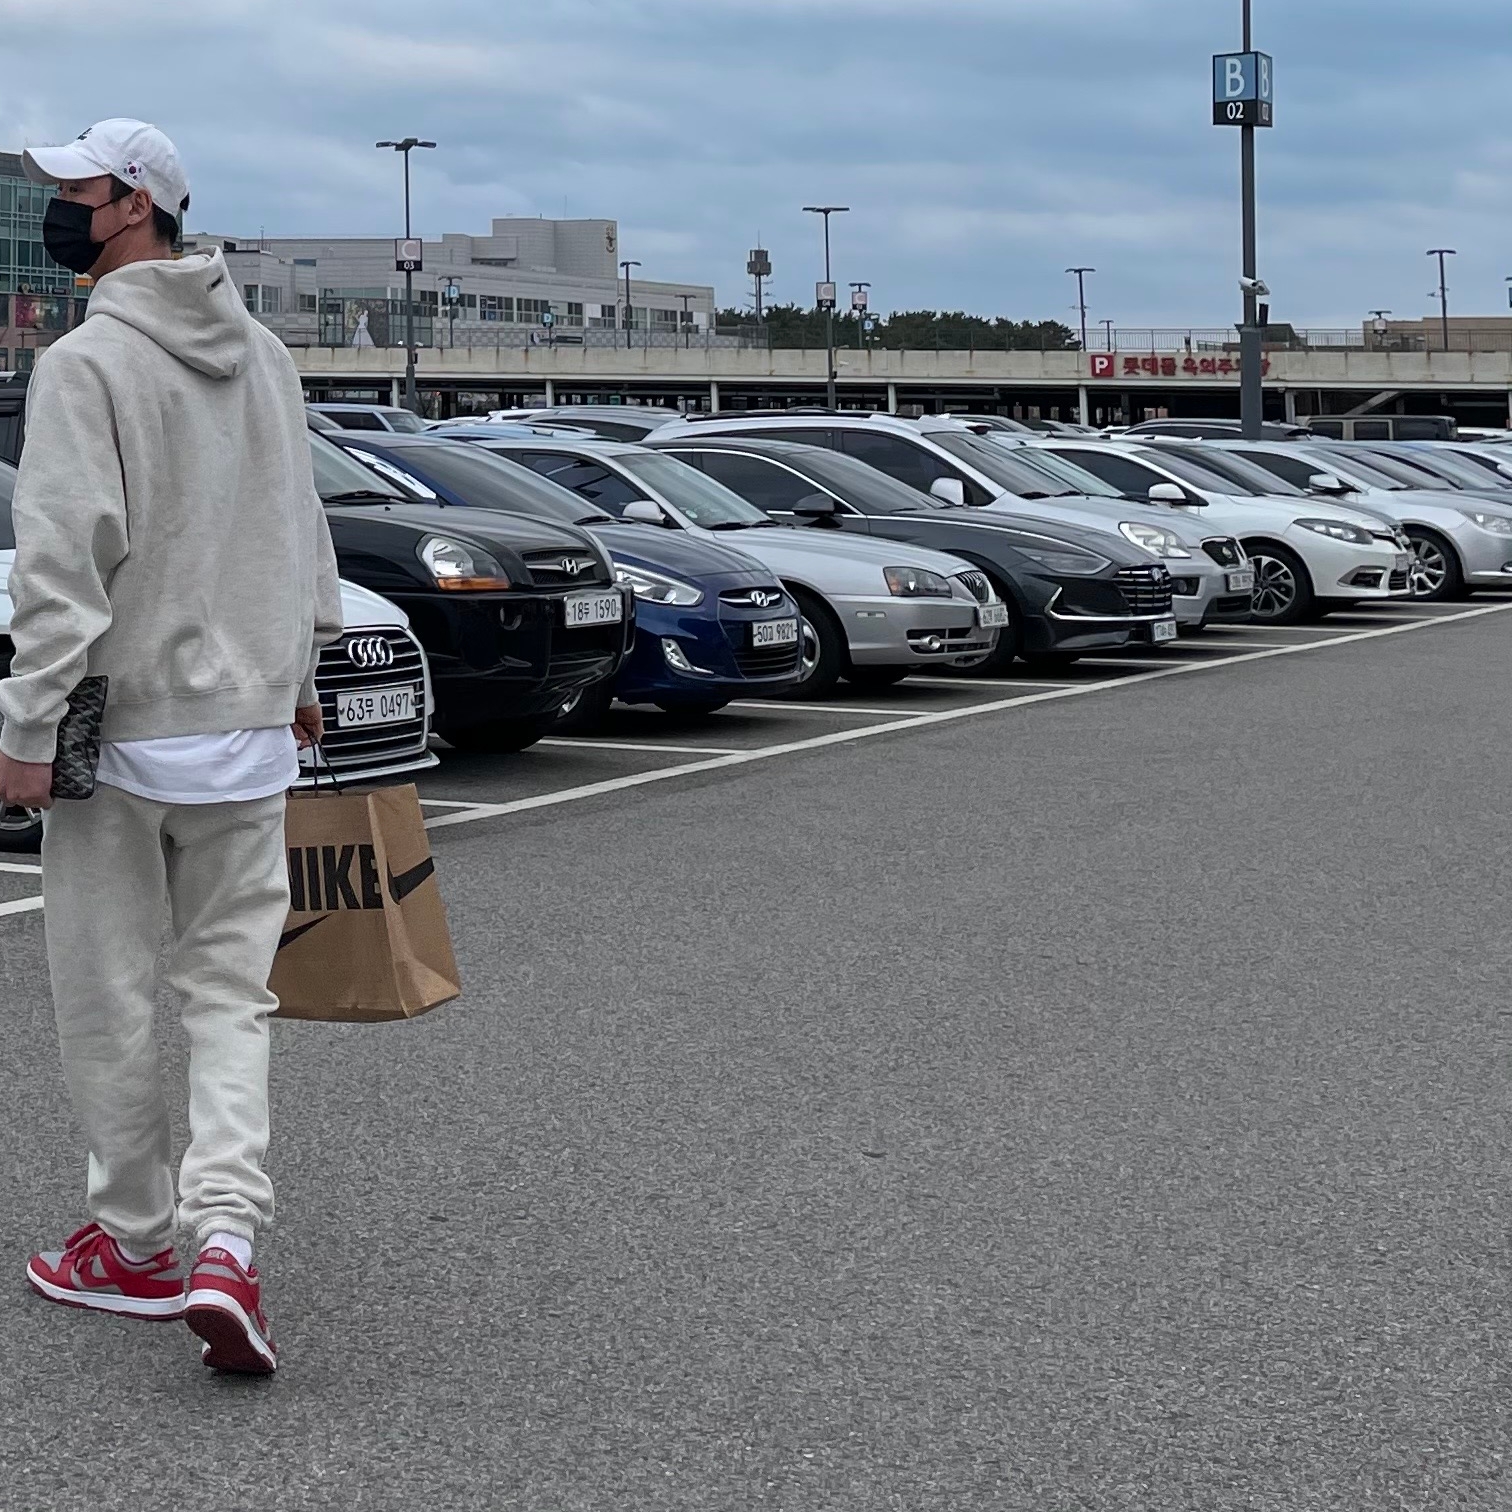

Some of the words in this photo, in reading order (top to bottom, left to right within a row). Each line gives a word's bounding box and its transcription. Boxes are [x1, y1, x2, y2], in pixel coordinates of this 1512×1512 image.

[1225, 57, 1245, 98] B
[1261, 58, 1269, 98] B
[1226, 101, 1245, 120] 02
[401, 240, 417, 260] C
[403, 261, 415, 271] 03
[820, 284, 832, 299] C
[855, 293, 866, 304] C
[543, 314, 552, 323] D
[863, 320, 874, 330] D
[1094, 356, 1109, 375] P
[1122, 356, 1178, 377] 롯데몰
[1182, 356, 1271, 377] 옥외주
[593, 598, 617, 620] 1590
[346, 697, 375, 722] 63무
[380, 692, 409, 718] 0497
